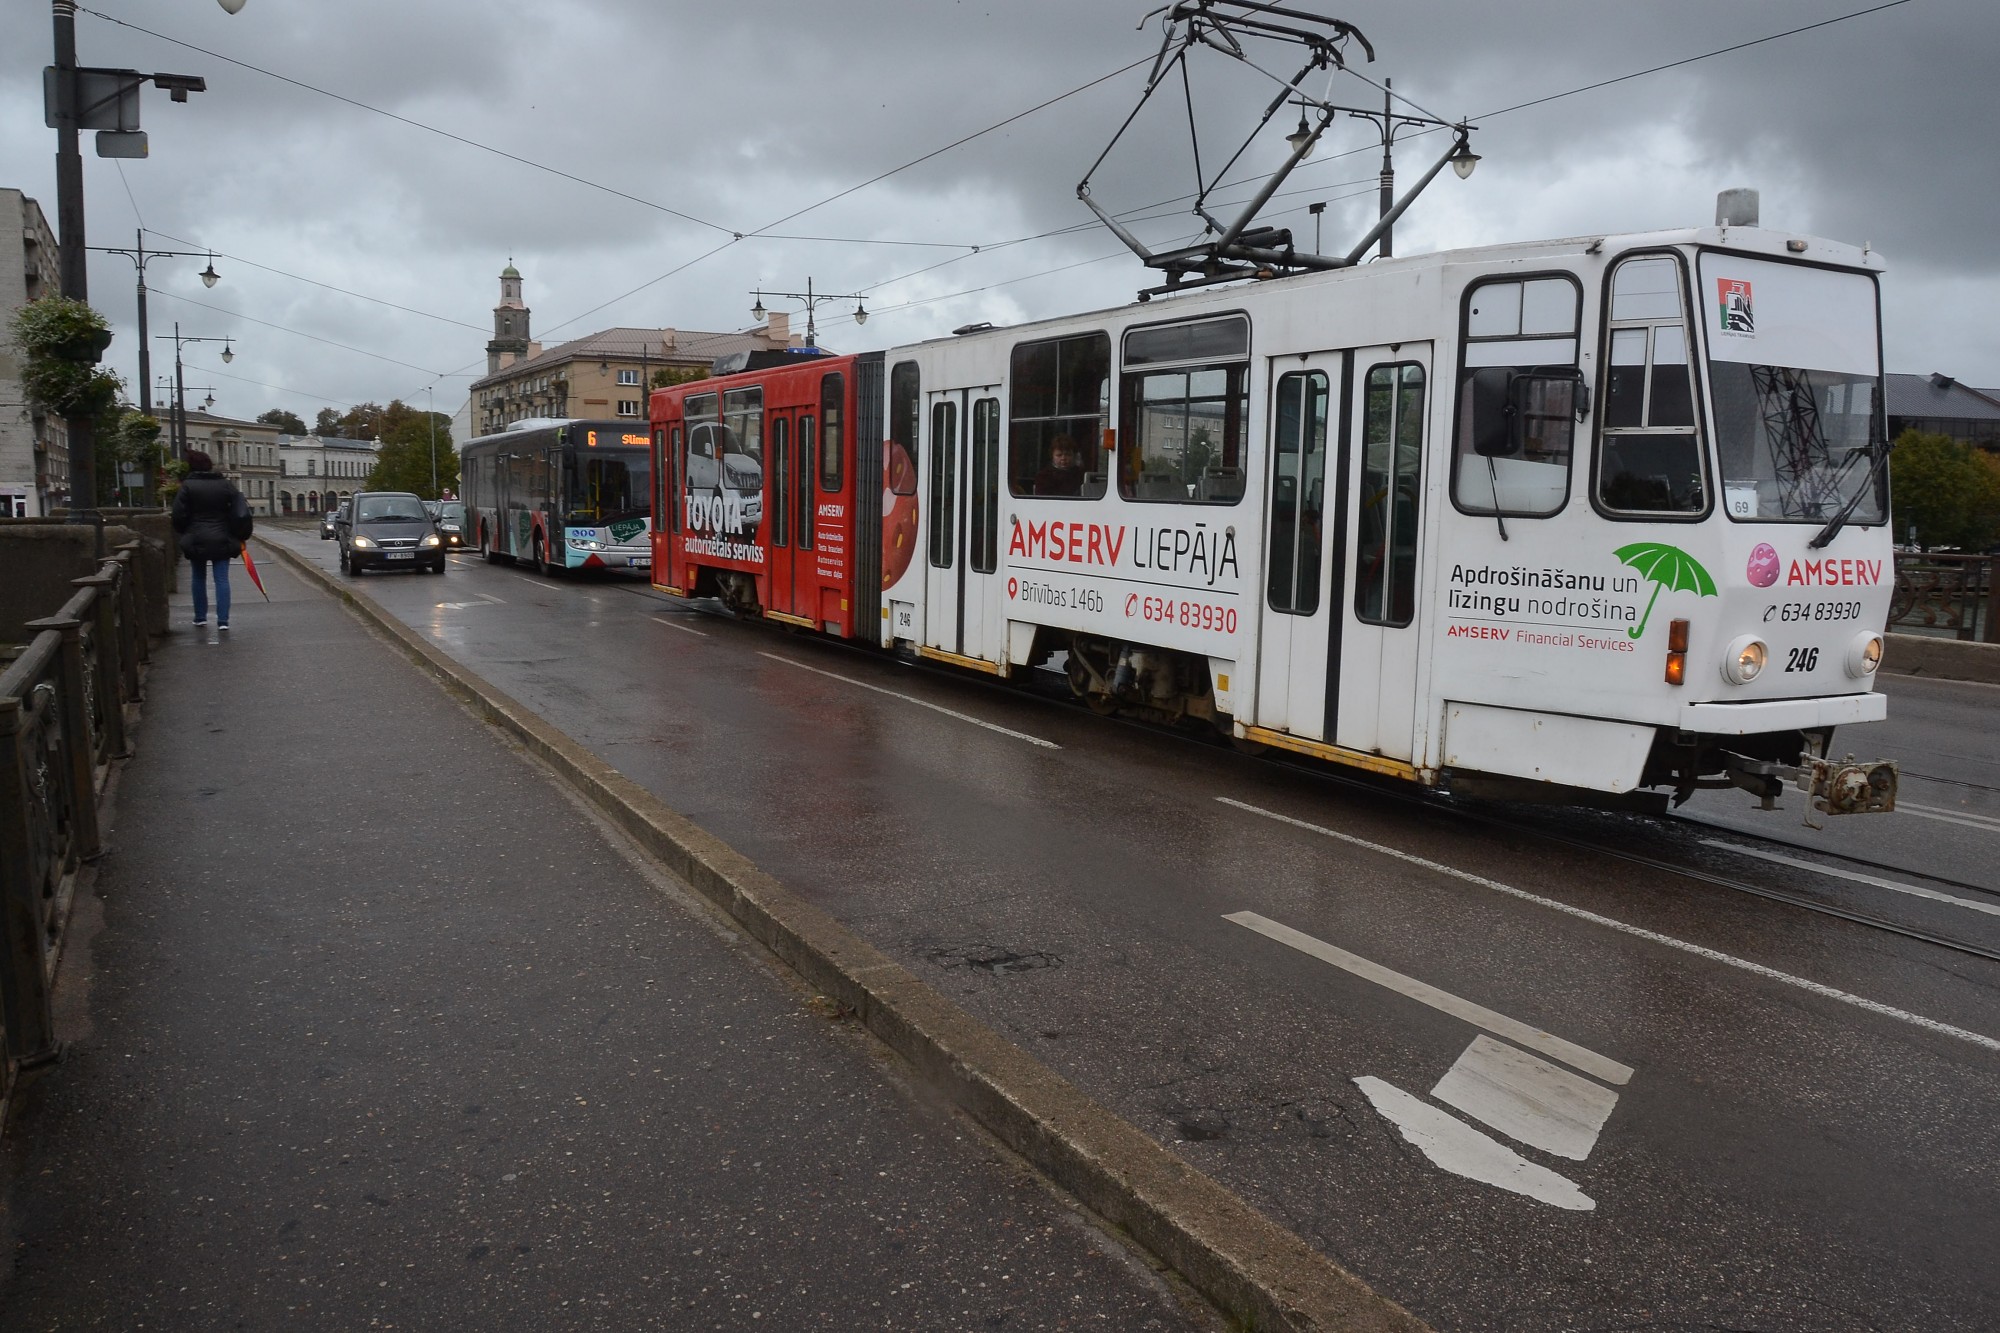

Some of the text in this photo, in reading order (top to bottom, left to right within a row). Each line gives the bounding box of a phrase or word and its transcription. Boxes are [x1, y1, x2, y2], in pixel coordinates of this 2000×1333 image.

[588, 431, 596, 446] 6
[684, 495, 743, 534] TOYOTA
[818, 504, 844, 517] AMSERV
[1735, 501, 1749, 514] 69
[611, 523, 640, 531] LIEPĀJA
[685, 535, 764, 563] autorizētais serviss
[1009, 519, 1239, 586] AMSERV LIEPĀJA
[1450, 564, 1638, 594] Apdrošināšanu un
[1787, 558, 1882, 587] AMSERV
[1021, 580, 1104, 613] Brīvības 146b
[1448, 589, 1637, 622] līzingu nodrošina
[900, 611, 911, 628] 246
[1143, 596, 1238, 635] 634 83930
[1781, 601, 1861, 623] 634 83930
[1447, 624, 1635, 652] AMSERV Financial Services
[1784, 647, 1820, 673] 246
